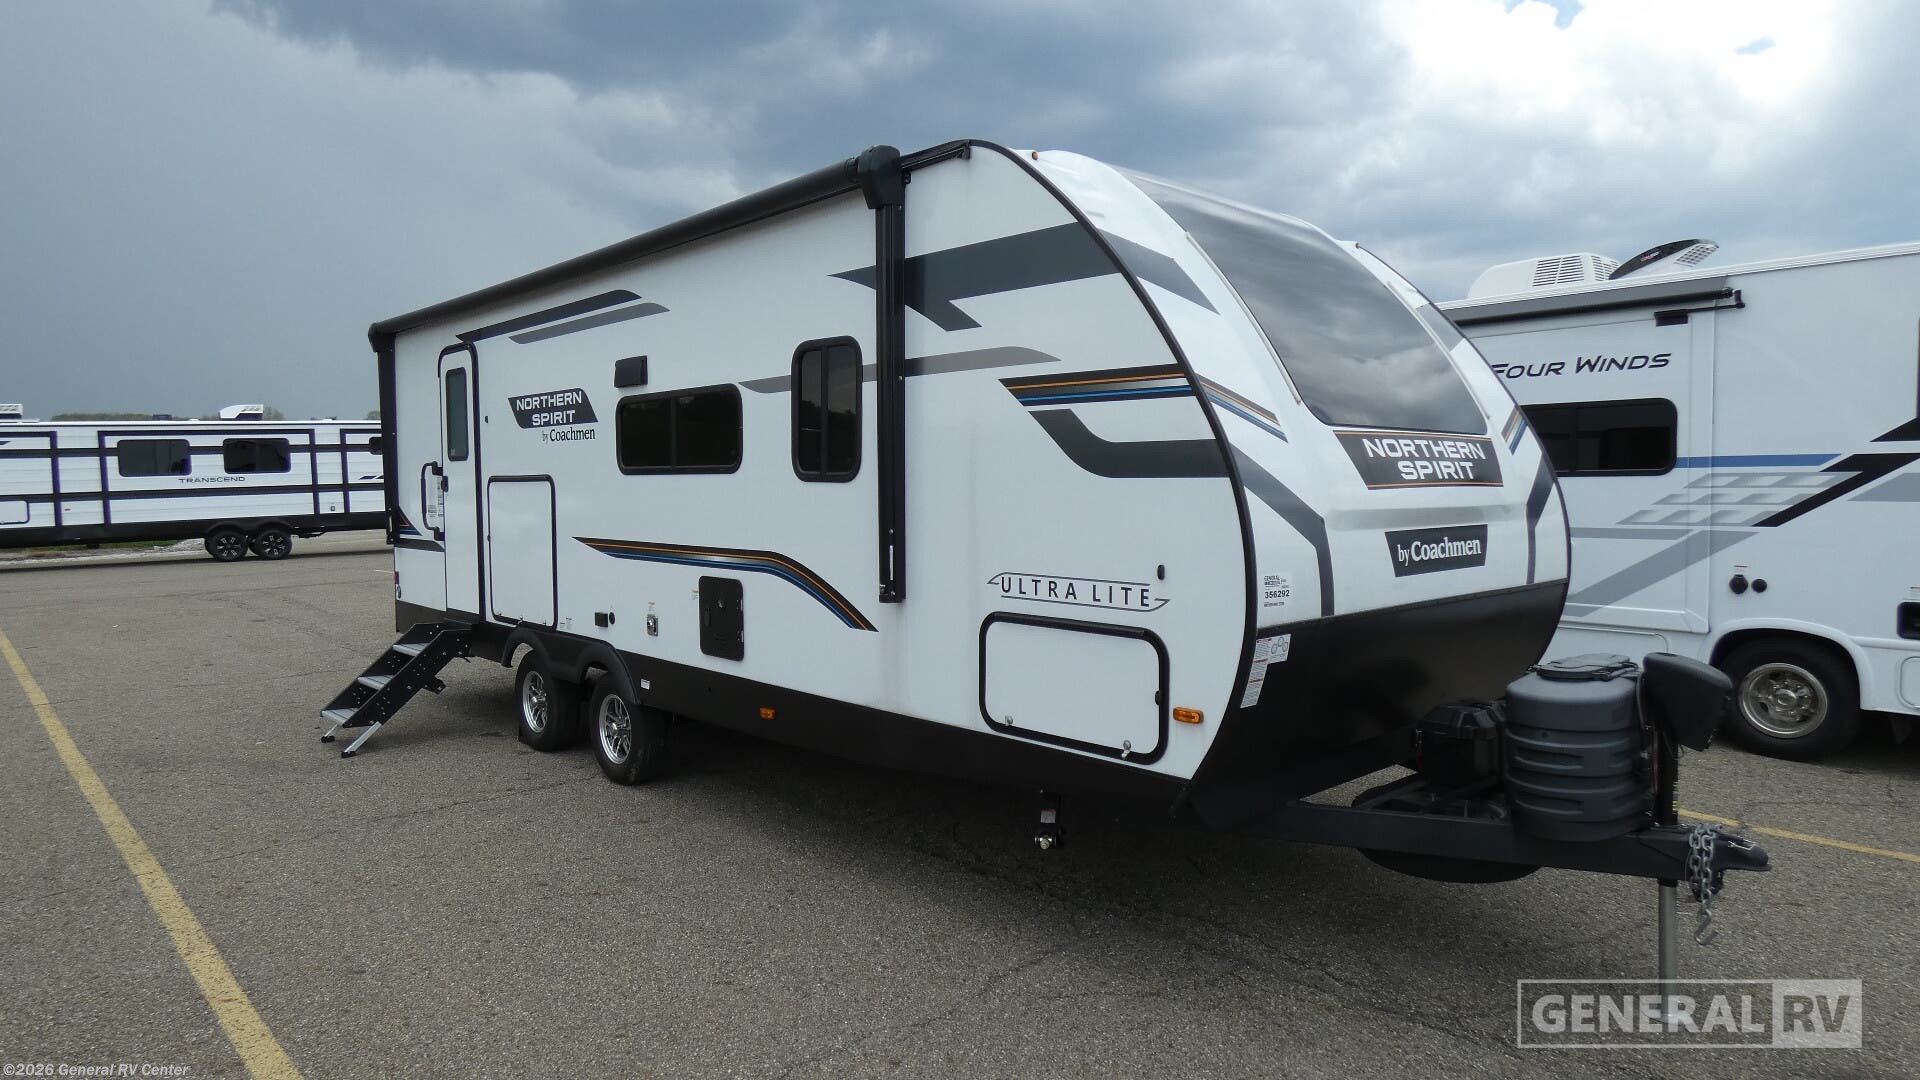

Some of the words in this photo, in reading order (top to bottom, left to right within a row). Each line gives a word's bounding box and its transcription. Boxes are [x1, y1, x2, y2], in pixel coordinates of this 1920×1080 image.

[1491, 362, 1565, 379] FOUR
[1575, 353, 1672, 374] WINDS
[516, 391, 582, 411] NORTHERN
[532, 410, 576, 426] SPIRIT
[549, 427, 596, 442] Coachmen
[1362, 438, 1487, 460] NORTHERN
[178, 476, 246, 484] TRANSCEND
[1398, 460, 1474, 480] SPIRIT
[1397, 544, 1410, 566] by
[1411, 536, 1481, 562] Coachmen
[1001, 576, 1077, 600] ULTRA
[1092, 584, 1150, 607] LITE
[1264, 590, 1290, 599] 356292
